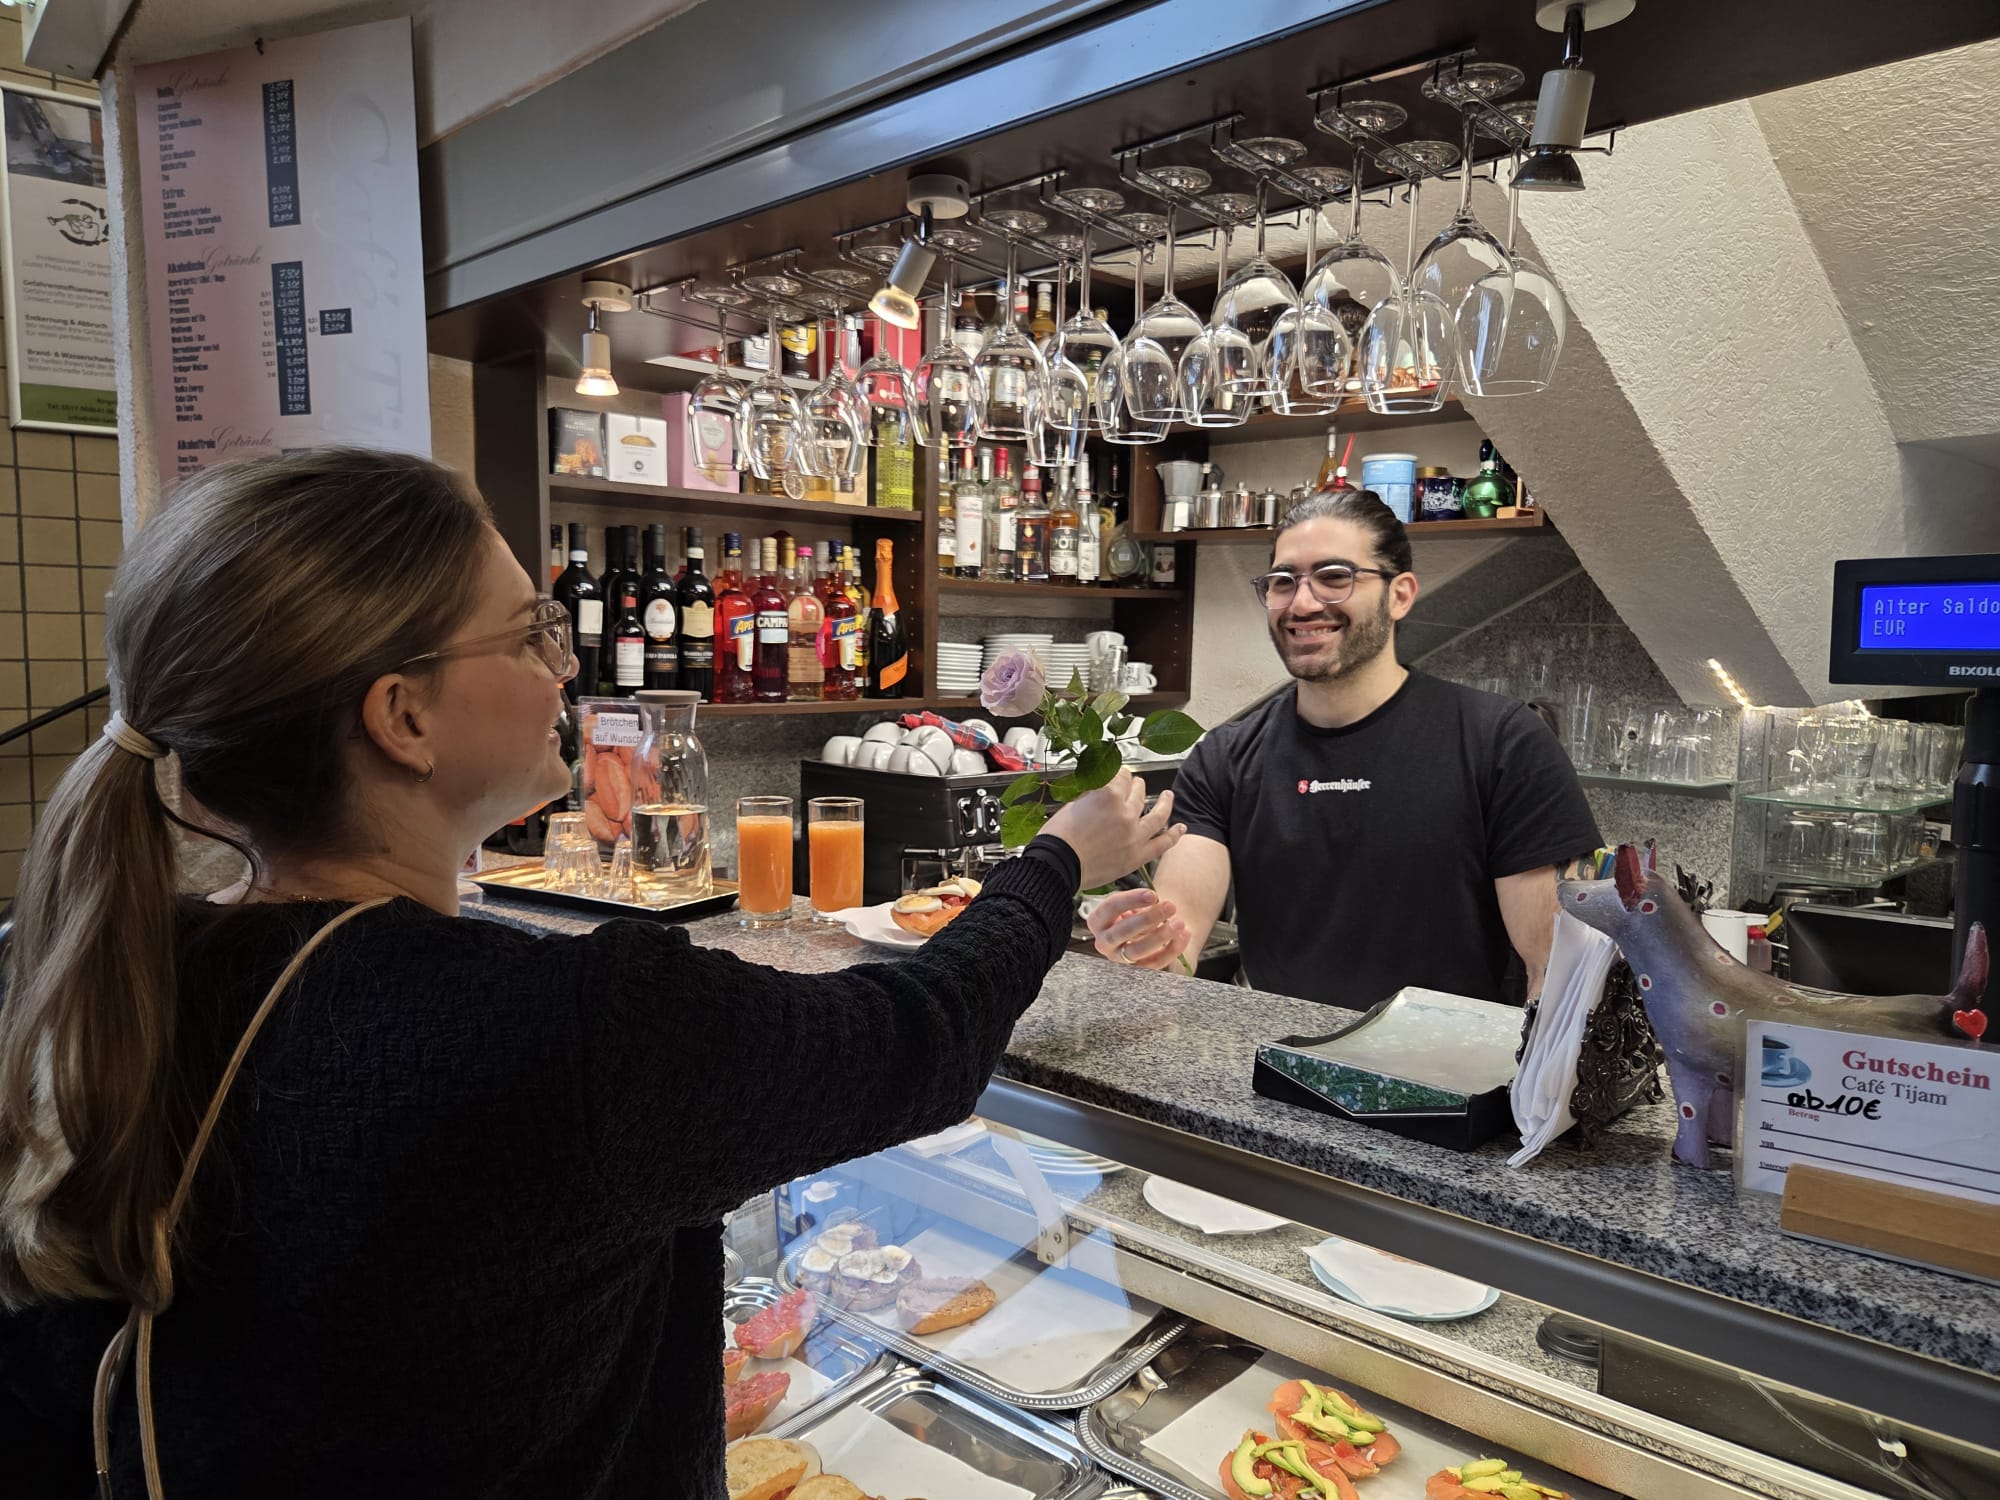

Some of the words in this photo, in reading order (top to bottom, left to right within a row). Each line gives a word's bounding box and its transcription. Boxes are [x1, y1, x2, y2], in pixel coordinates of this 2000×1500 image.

[202, 244, 262, 273] Getränke
[211, 425, 274, 455] Getränke
[1874, 599, 1929, 615] Alter
[1943, 597, 2000, 614] Saldo
[1873, 619, 1905, 636] EUR
[600, 715, 640, 728] Brötchen
[595, 733, 608, 743] auf
[1842, 1049, 1991, 1090] Gutschein
[1841, 1074, 1885, 1096] Café
[1891, 1082, 1948, 1106] Tijam
[1788, 1108, 1820, 1122] Betrag
[1760, 1139, 1775, 1148] von
